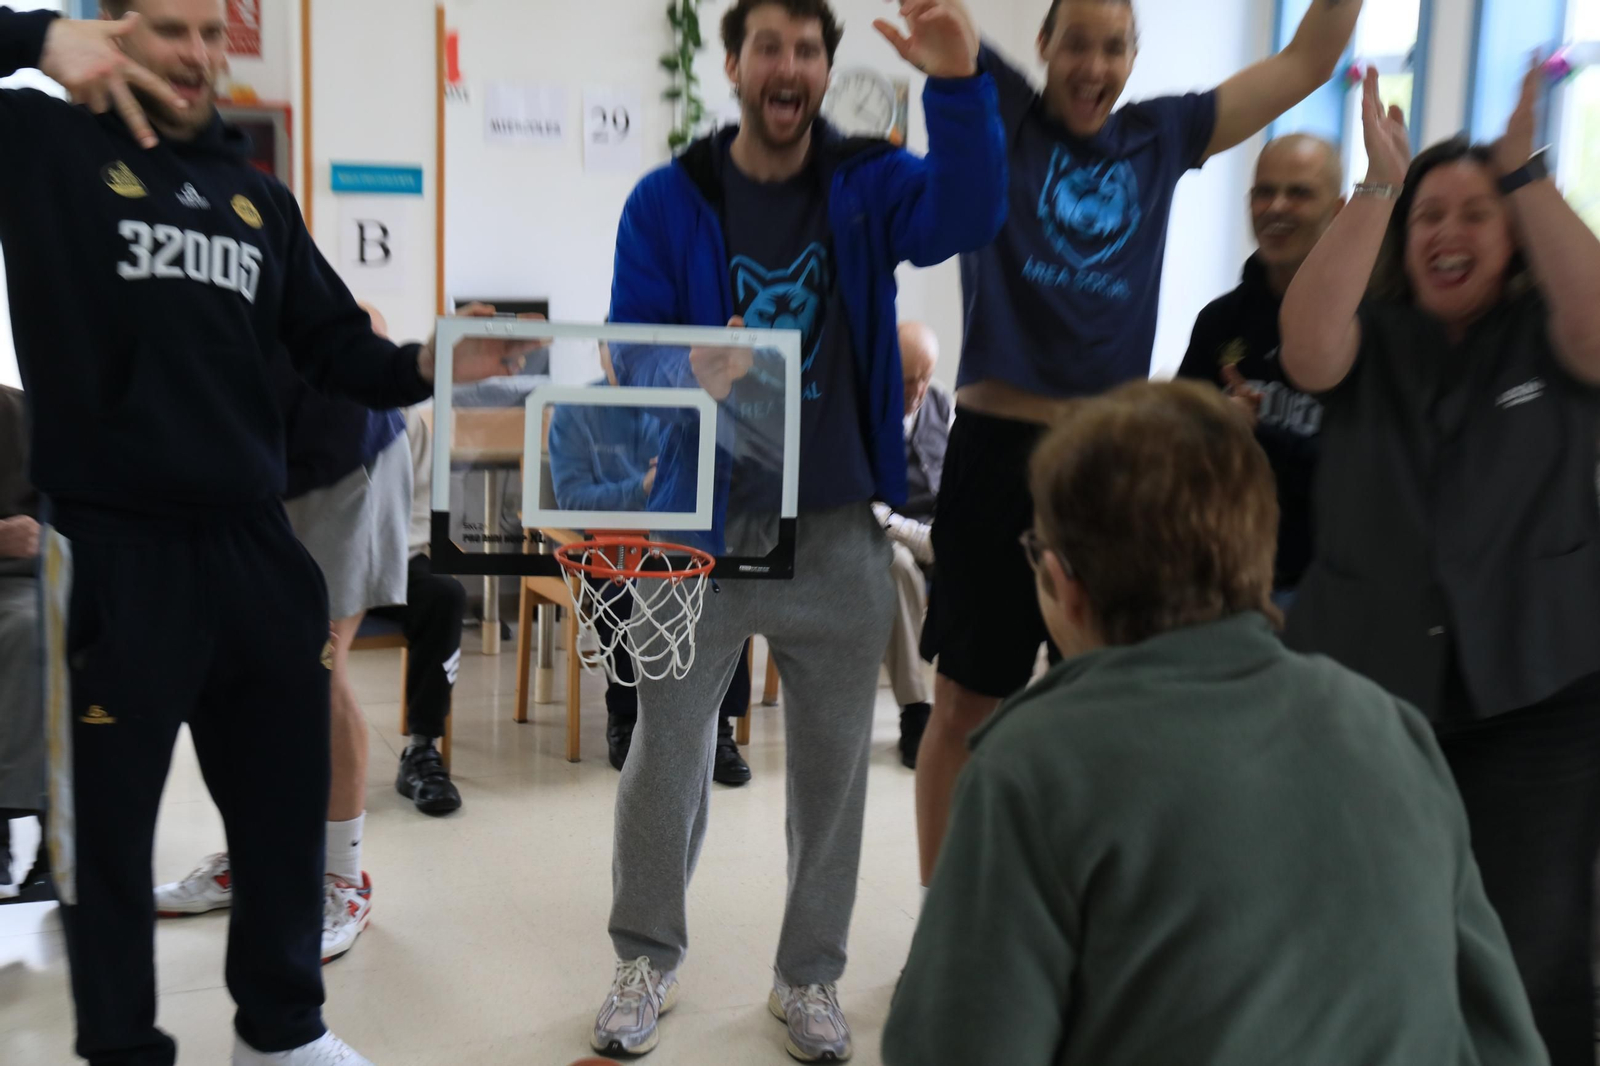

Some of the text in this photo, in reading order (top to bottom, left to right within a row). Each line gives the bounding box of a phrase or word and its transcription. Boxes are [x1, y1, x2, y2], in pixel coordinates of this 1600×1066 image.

[591, 105, 629, 143] 29
[116, 219, 263, 304] 32005
[354, 219, 392, 268] B
